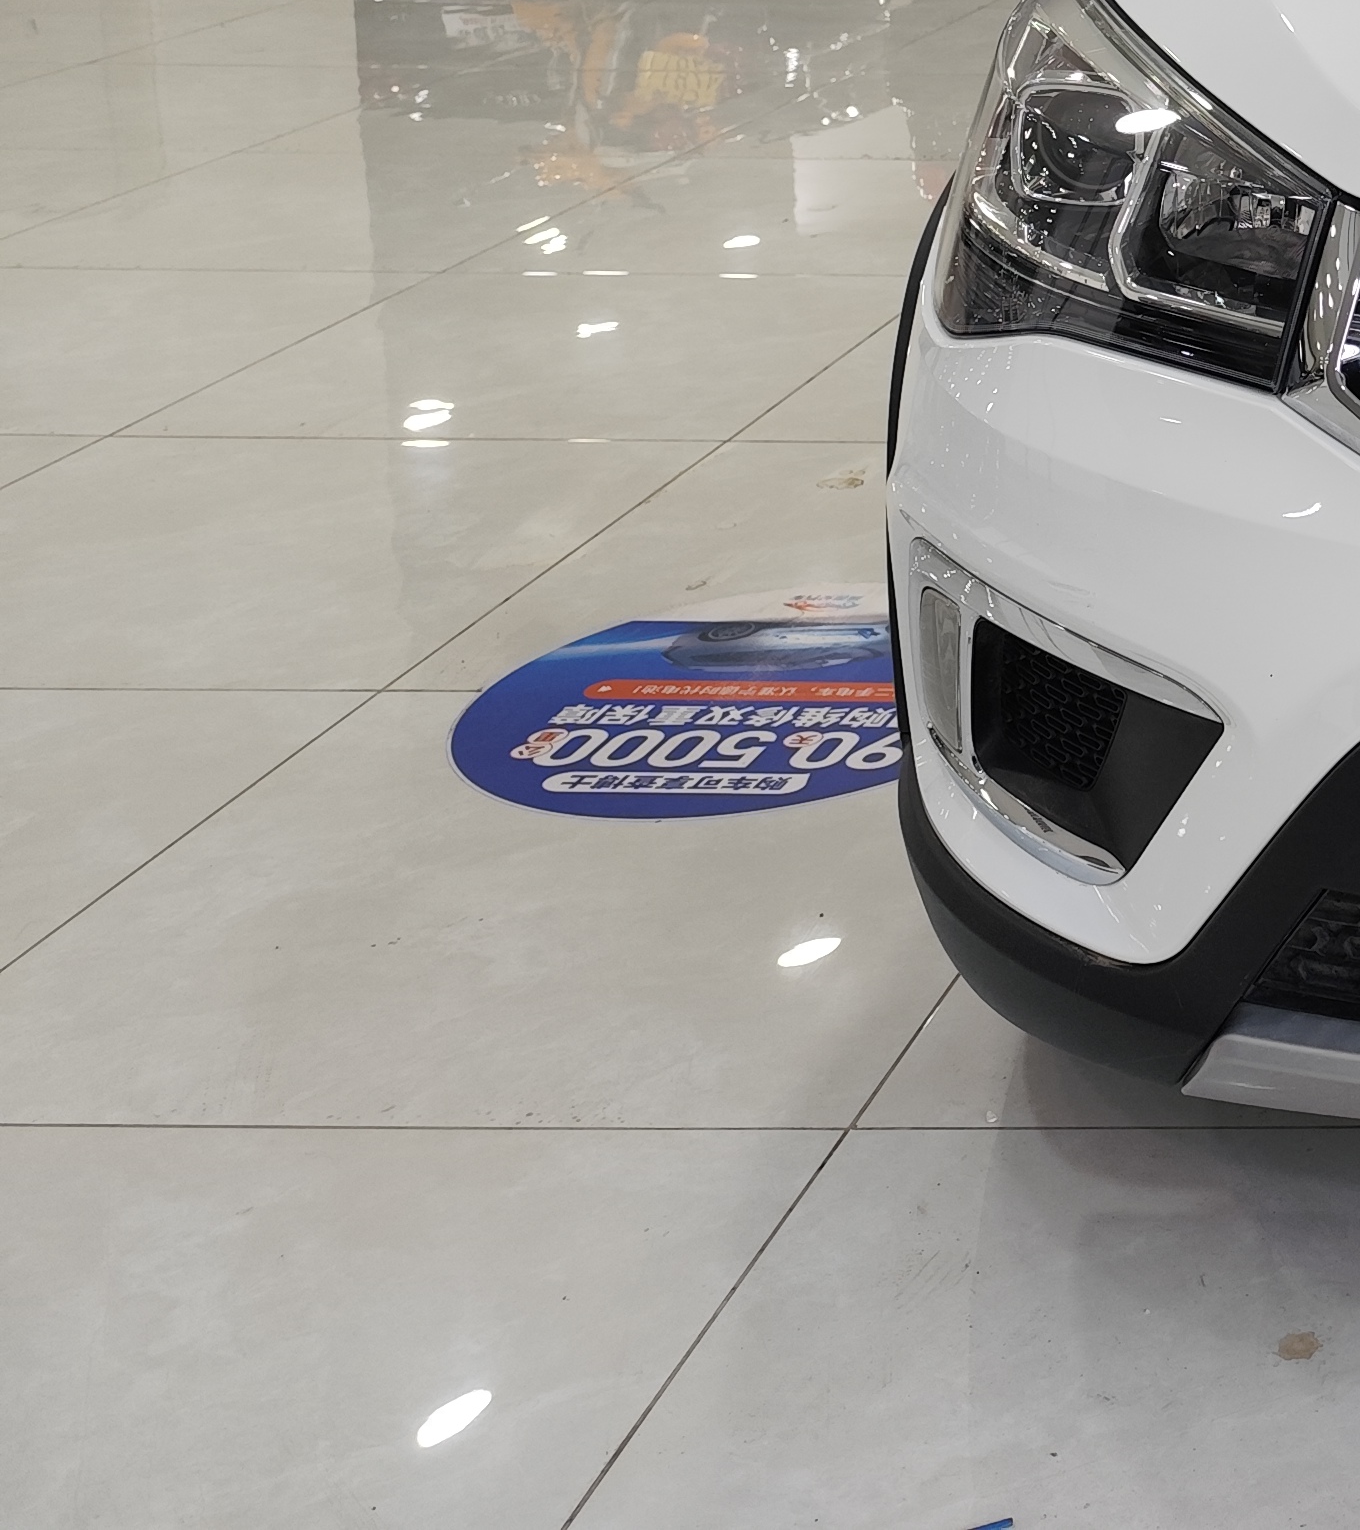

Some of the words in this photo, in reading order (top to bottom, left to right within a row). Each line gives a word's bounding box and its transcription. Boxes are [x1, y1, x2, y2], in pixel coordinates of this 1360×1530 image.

[548, 703, 899, 729] 购维修双重保障
